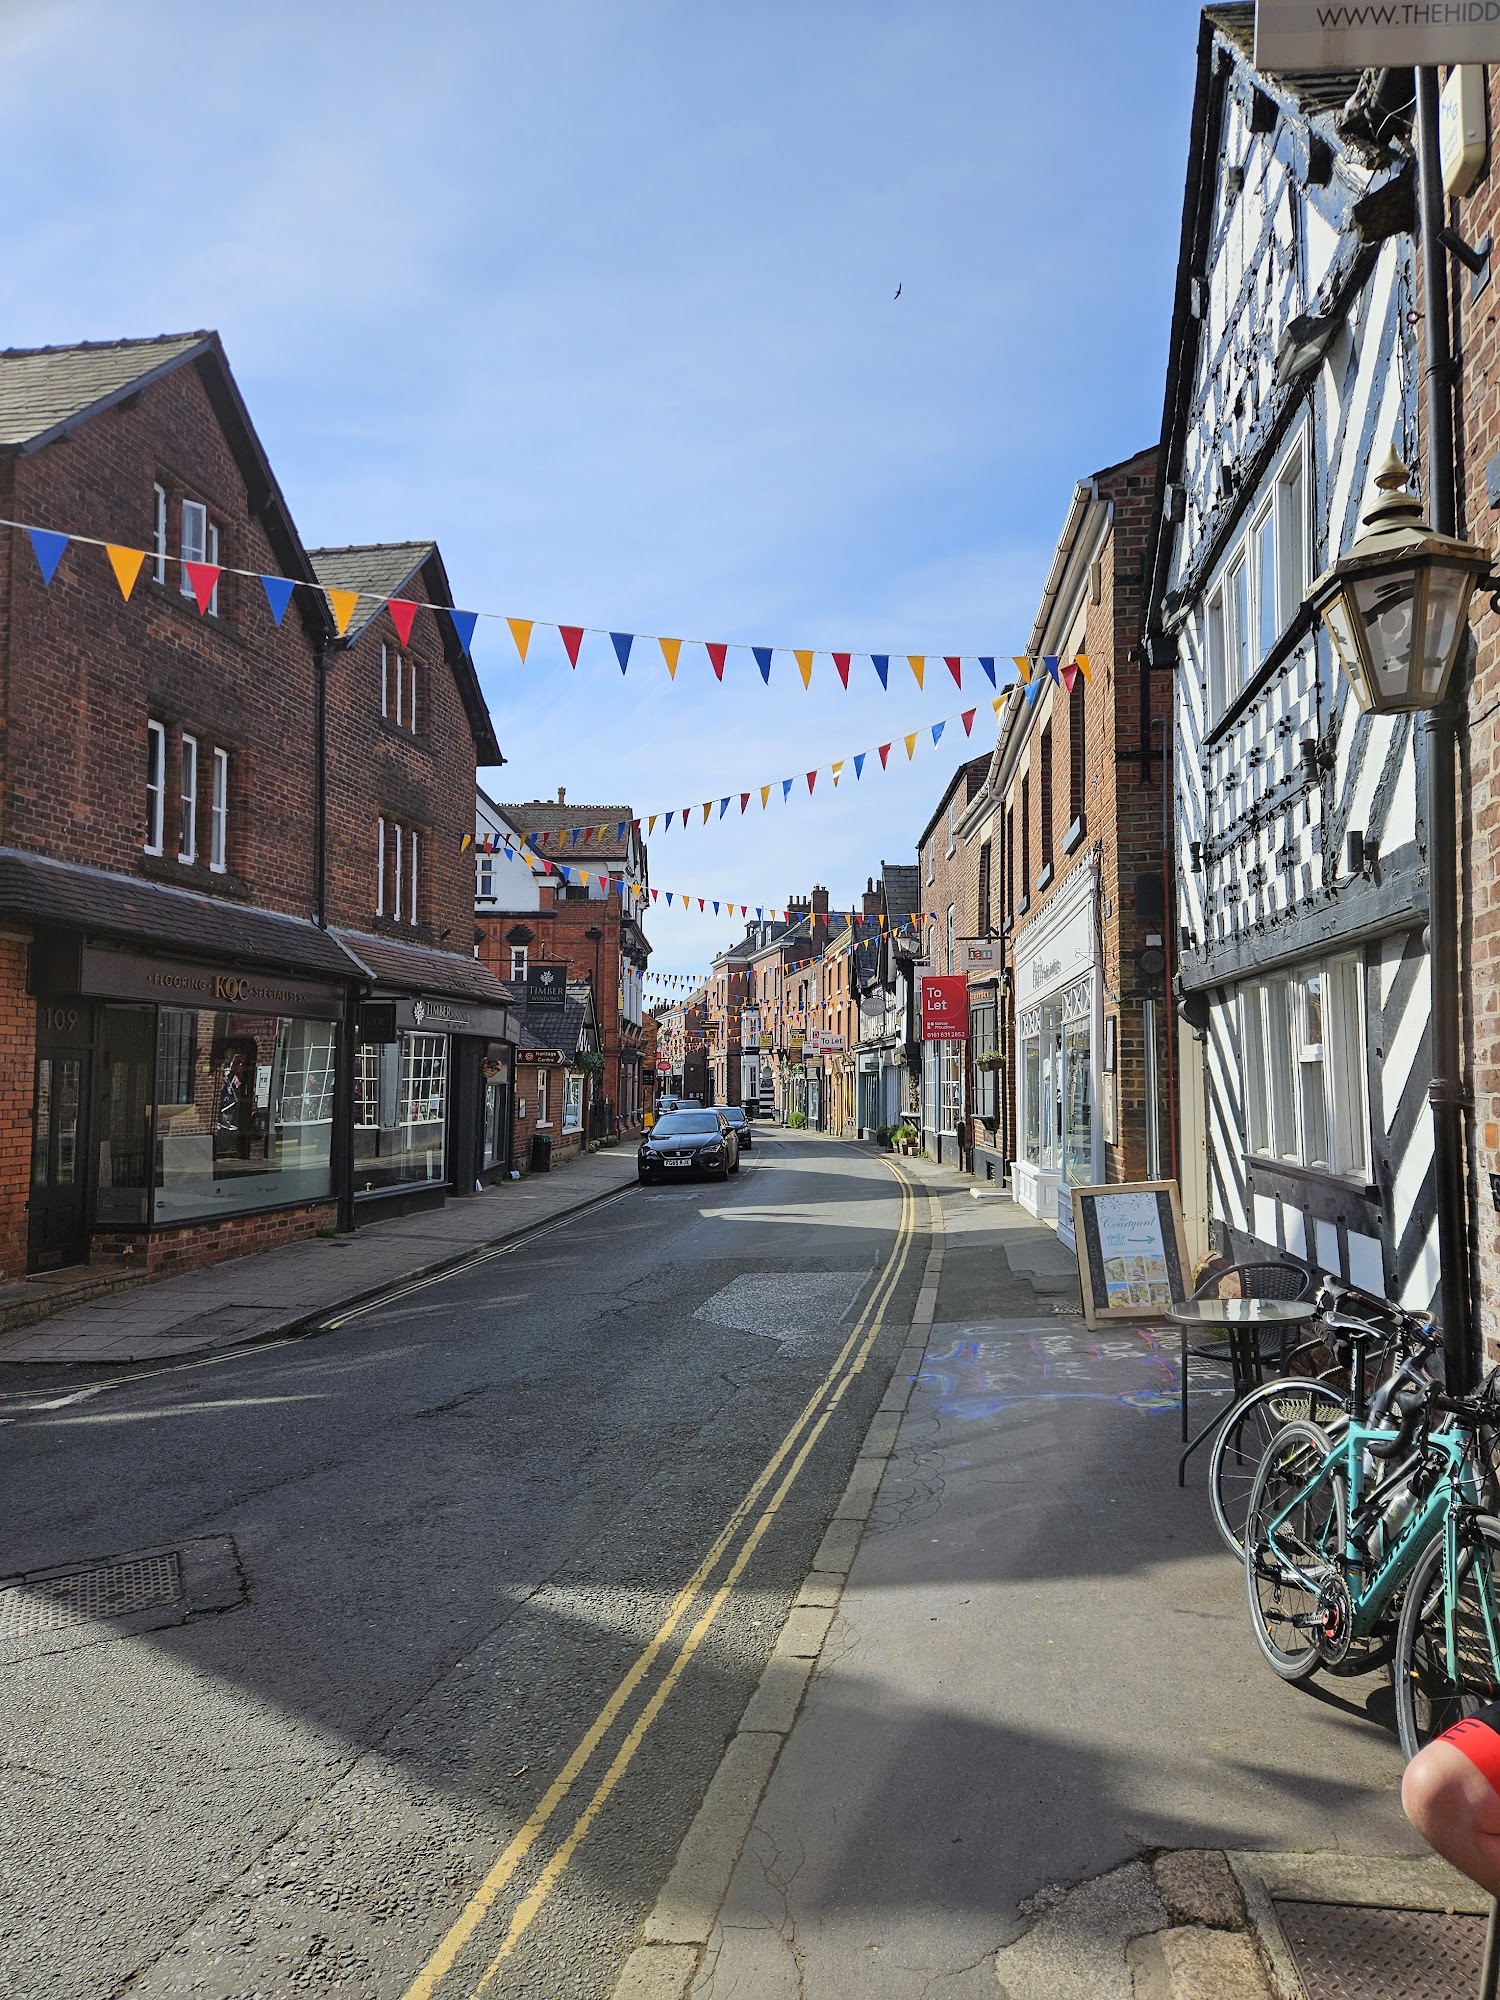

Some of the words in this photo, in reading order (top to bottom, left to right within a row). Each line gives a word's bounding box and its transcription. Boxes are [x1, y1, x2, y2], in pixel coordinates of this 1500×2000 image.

[153, 973, 207, 991] FLOORING
[214, 975, 250, 1003] KQC
[253, 987, 301, 1002] SPECIALISTS
[528, 986, 564, 995] TIMBER
[926, 987, 942, 998] To
[426, 1001, 451, 1018] TIMBER
[927, 1000, 947, 1011] Let
[46, 1008, 77, 1031] 109
[1100, 1216, 1156, 1232] Courtyard
